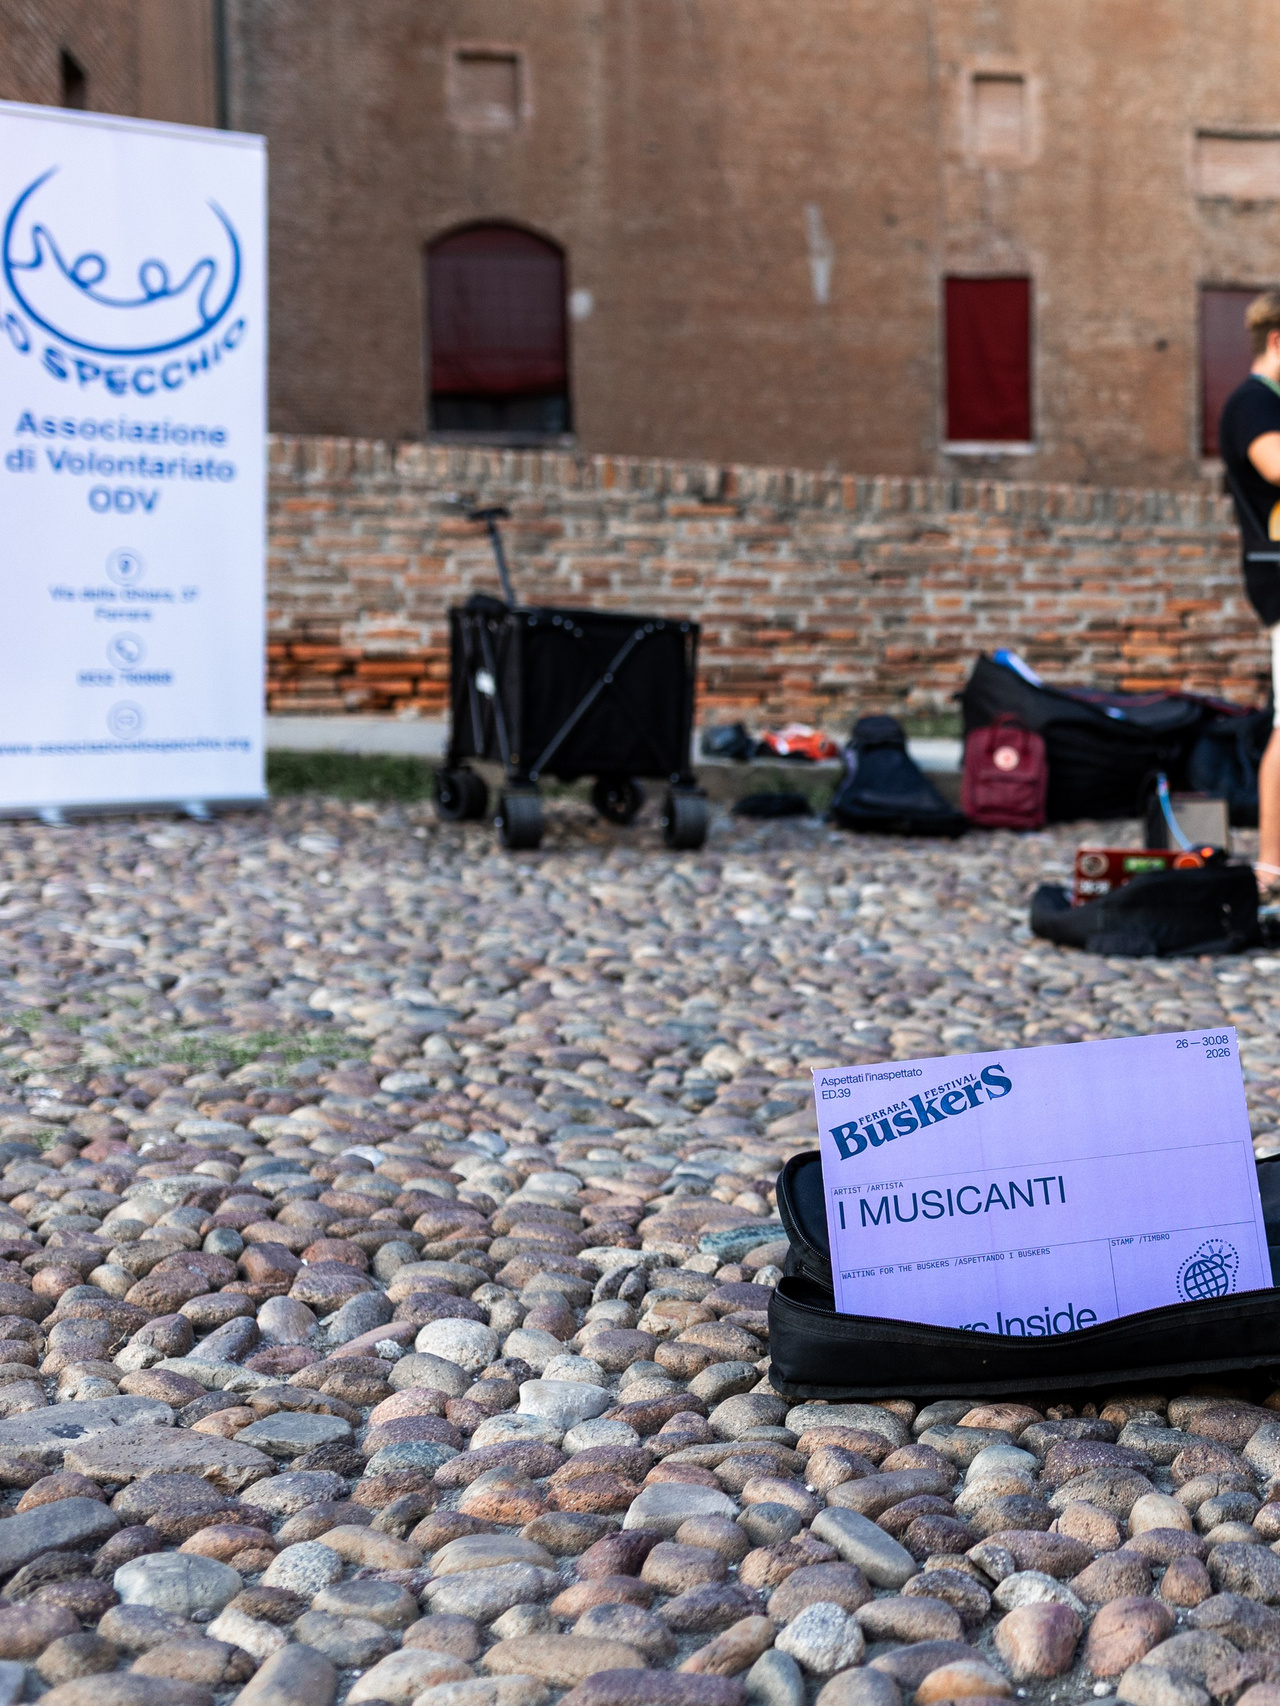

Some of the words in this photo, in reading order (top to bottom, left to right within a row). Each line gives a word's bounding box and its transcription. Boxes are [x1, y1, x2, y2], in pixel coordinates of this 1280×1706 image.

[0, 312, 31, 353] O
[42, 317, 247, 396] SPECCHIO
[16, 410, 228, 446] Associazione
[5, 449, 35, 473] di
[46, 449, 237, 481] Volontariato
[88, 485, 158, 514] ODV
[1176, 1039, 1189, 1049] 26
[1202, 1035, 1229, 1046] 30.08
[1205, 1048, 1231, 1058] 2026
[821, 1073, 864, 1087] Aspettati
[865, 1067, 923, 1082] l'inaspettato
[822, 1088, 851, 1100] ED.39
[858, 1101, 908, 1125] FERRARA
[924, 1073, 977, 1099] FESTIVAL
[833, 1186, 862, 1195] ARTIST
[866, 1182, 904, 1192] /ARTISTA
[838, 1201, 846, 1229] I
[860, 1175, 1066, 1227] MUSICANTI
[1111, 1237, 1134, 1247] STAMP
[1139, 1233, 1171, 1244] /TIMBRO
[841, 1269, 876, 1280] WAITING
[879, 1267, 894, 1275] FOR
[899, 1264, 913, 1273] THE
[916, 1260, 950, 1271] BUSKERS
[954, 1254, 1005, 1266] /ASPETTANDO
[1018, 1248, 1051, 1258] BUSKERS
[997, 1302, 1098, 1336] Inside
